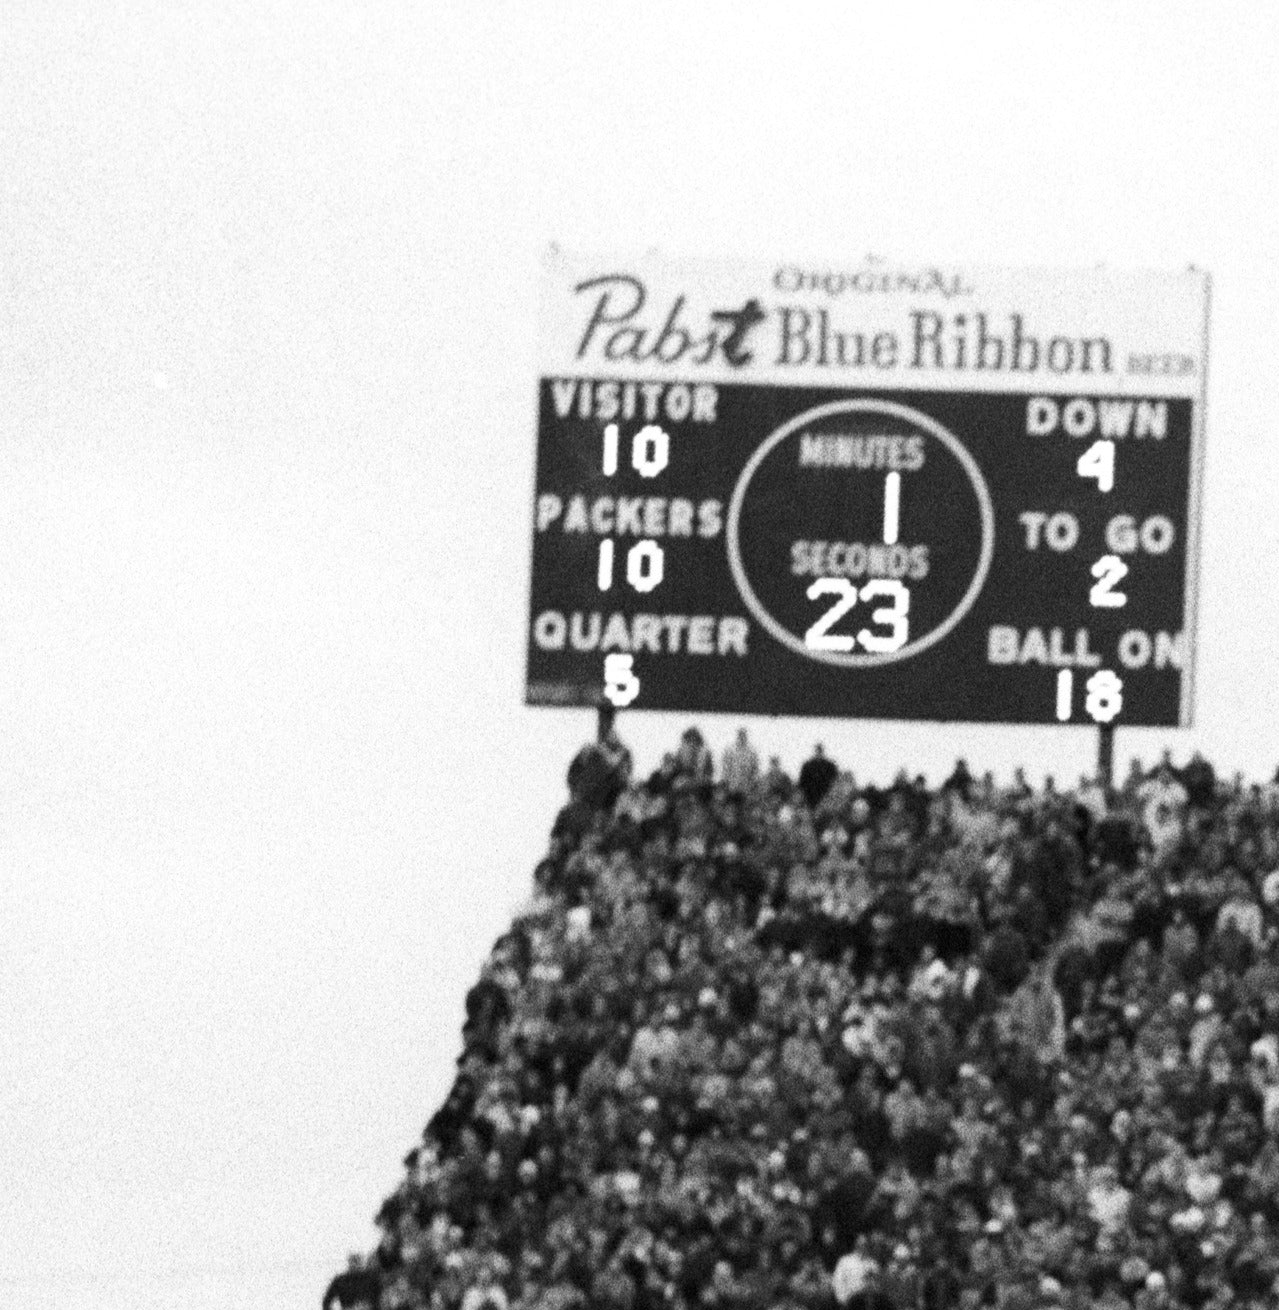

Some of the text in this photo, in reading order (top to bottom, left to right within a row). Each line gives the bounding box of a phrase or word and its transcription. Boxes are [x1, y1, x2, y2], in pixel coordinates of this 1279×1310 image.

[573, 274, 767, 368] Pabst
[774, 306, 899, 369] Blue
[908, 308, 1114, 374] Ribbon
[551, 382, 719, 422] VISITOR
[1026, 398, 1168, 440] DOWN
[602, 423, 670, 478] 10
[801, 433, 926, 471] MINUTES
[1076, 439, 1115, 492] 4
[535, 495, 722, 538] PACKERS
[883, 471, 901, 545] 1
[1019, 511, 1175, 554] TO GO
[597, 538, 665, 593] 10
[790, 540, 930, 579] SECONDS
[1089, 554, 1128, 608] 2
[532, 611, 749, 656] QUARTER
[805, 577, 911, 653] 23
[987, 626, 1185, 668] BALL ON
[603, 653, 641, 706] 5
